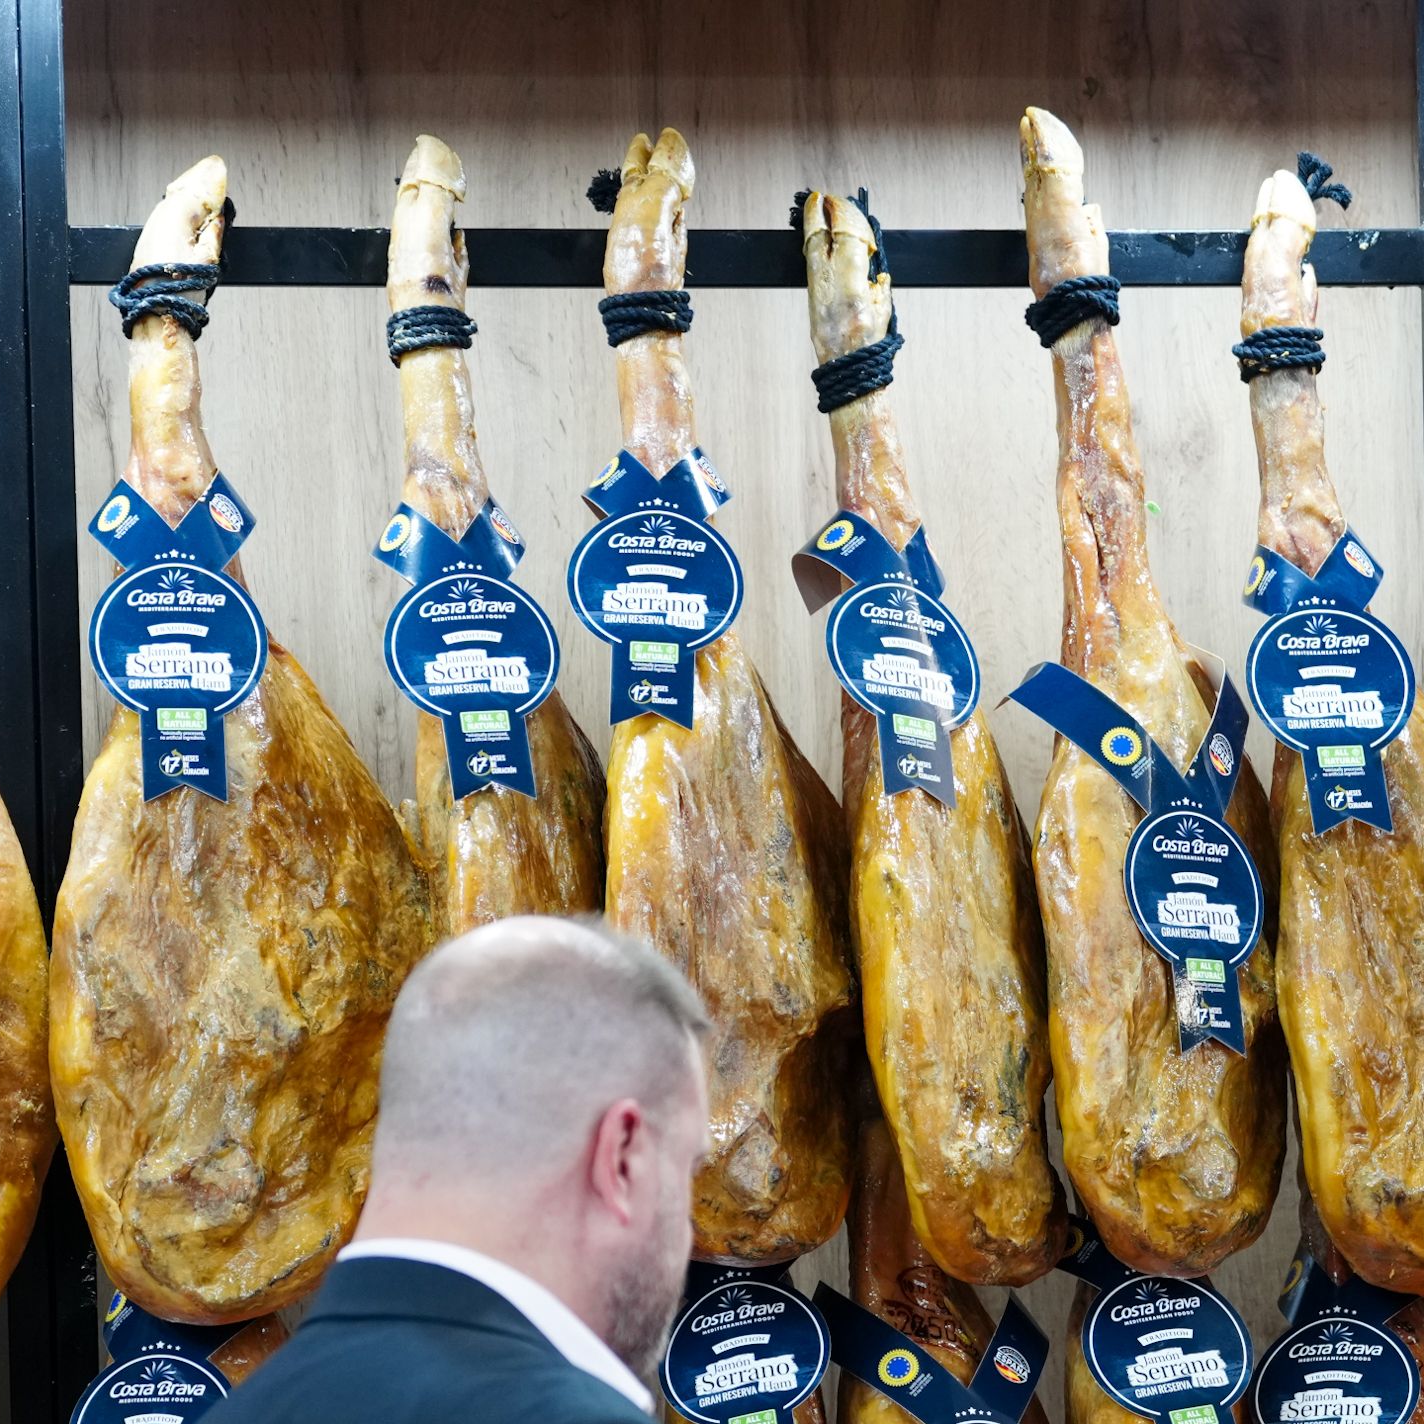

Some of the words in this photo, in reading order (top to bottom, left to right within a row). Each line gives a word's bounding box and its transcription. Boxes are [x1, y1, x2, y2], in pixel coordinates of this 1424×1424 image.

[609, 532, 656, 549] Costa
[657, 535, 707, 553] Brava
[127, 589, 174, 607] Costa
[176, 589, 227, 608] Brava
[420, 600, 466, 618] Costa
[467, 598, 517, 614] Brava
[611, 592, 701, 614] Serrano
[1277, 635, 1321, 652] Costa
[1322, 633, 1370, 648] Brava
[133, 654, 226, 675] Serrano
[431, 662, 523, 682] Serrano
[1289, 697, 1377, 717] Serrano
[1153, 834, 1190, 854] Costa
[1191, 838, 1231, 860] Brava
[1162, 902, 1236, 928] Serrano
[690, 1309, 735, 1332] Costa
[736, 1302, 785, 1320] Brava
[1288, 1342, 1334, 1359] Costa
[1334, 1341, 1383, 1356] Brava
[1288, 1342, 1334, 1359] Costa
[1334, 1341, 1384, 1356] Brava
[1297, 1355, 1349, 1364] MEDITERRANEAN
[701, 1360, 791, 1393] Serrano
[1310, 1372, 1357, 1381] TRADITION
[1300, 1392, 1338, 1403] Jamón
[1287, 1400, 1374, 1419] Serrano
[1287, 1400, 1374, 1419] Serrano
